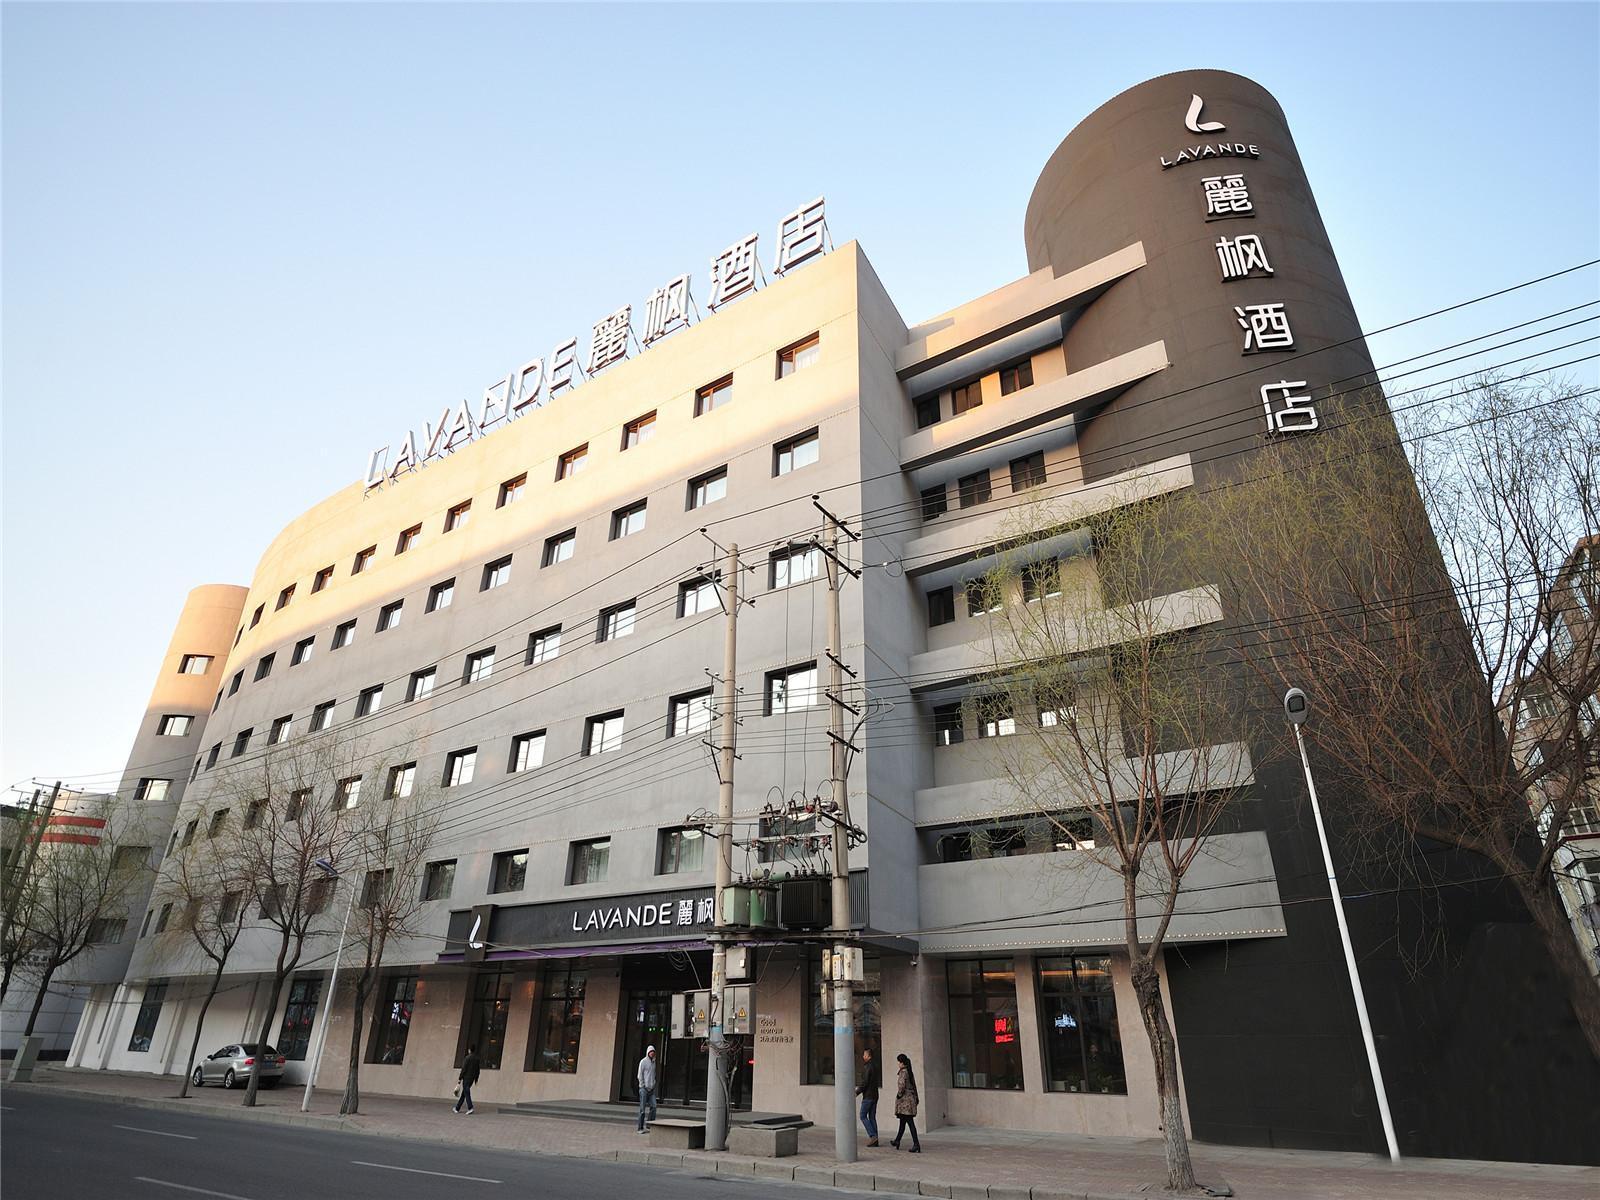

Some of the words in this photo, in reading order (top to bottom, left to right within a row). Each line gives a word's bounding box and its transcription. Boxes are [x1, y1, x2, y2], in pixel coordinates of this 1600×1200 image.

[1160, 143, 1260, 169] LAVANDE
[364, 336, 578, 490] LAVANDE
[587, 196, 827, 374] 麗枫酒店
[1201, 173, 1319, 433] 麗枫酒店
[572, 902, 673, 931] LAVANDE
